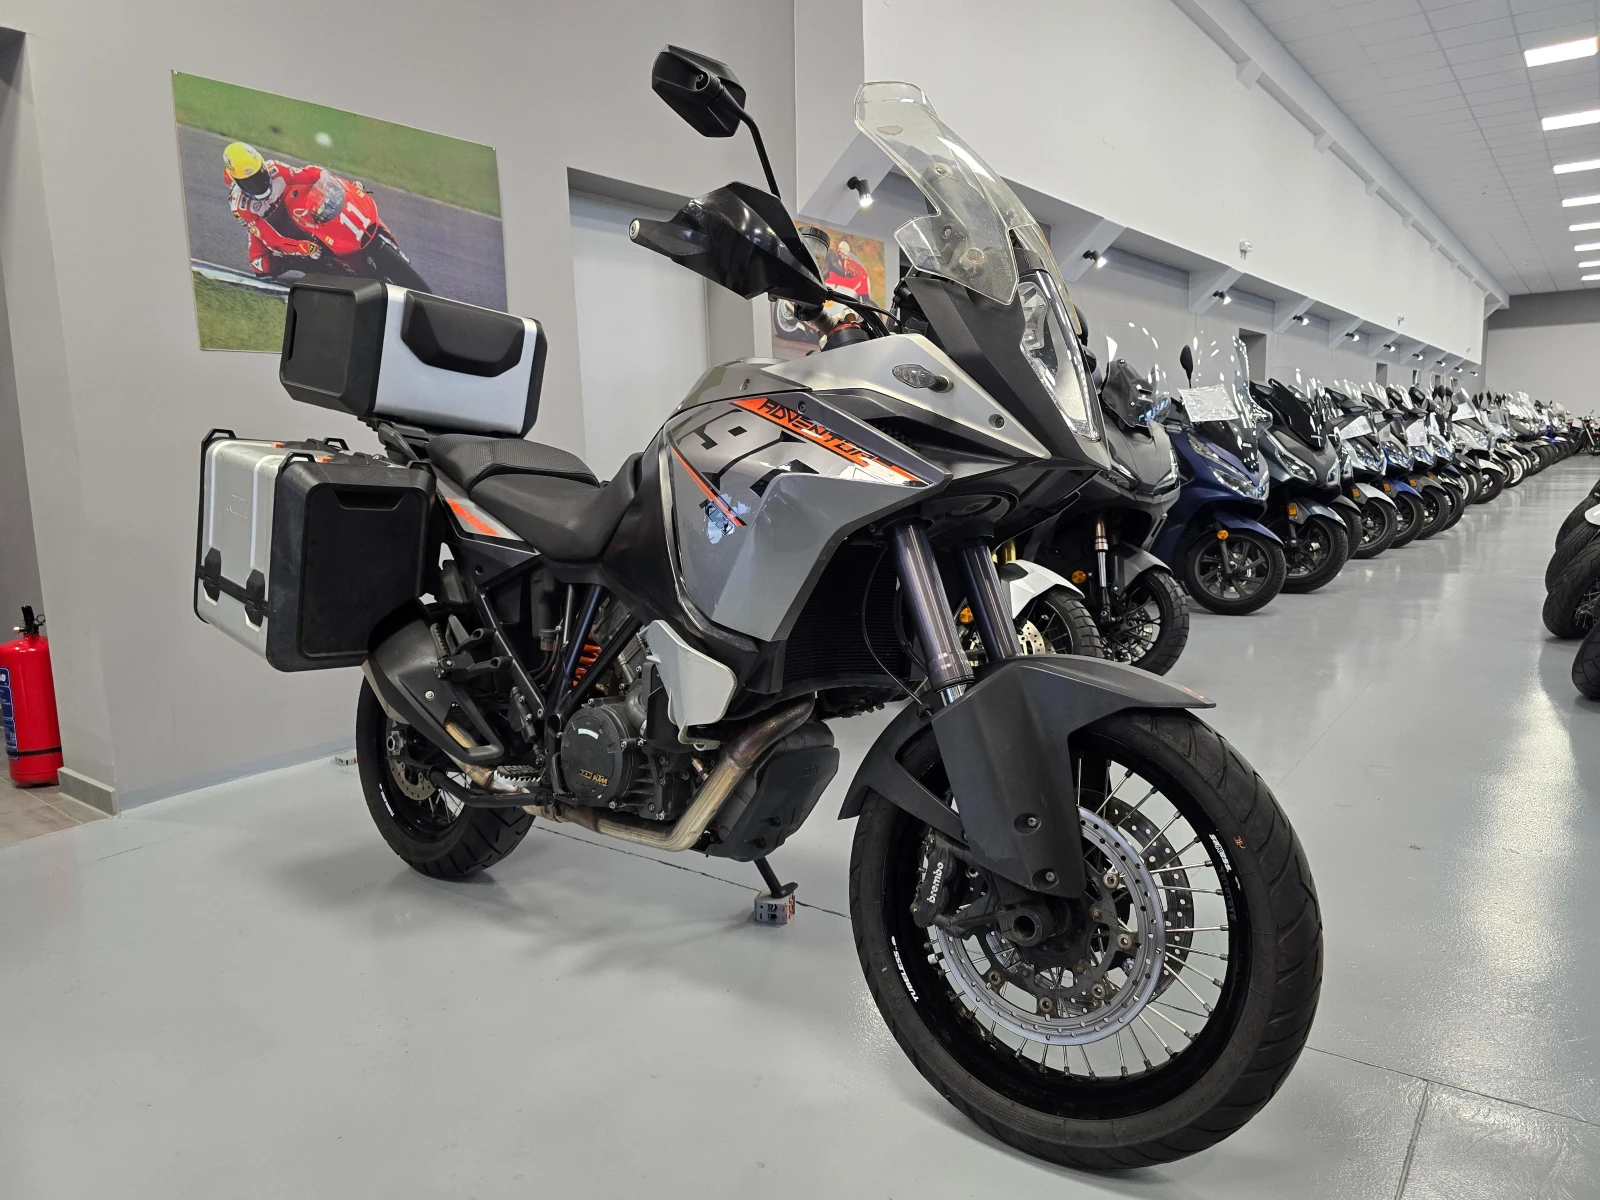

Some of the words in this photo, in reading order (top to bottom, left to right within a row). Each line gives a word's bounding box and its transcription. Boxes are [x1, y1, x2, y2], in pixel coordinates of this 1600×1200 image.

[340, 201, 371, 242] 11
[757, 400, 895, 468] ADVENTUR
[926, 861, 944, 904] brembo
[893, 950, 920, 1003] TUBELESS
